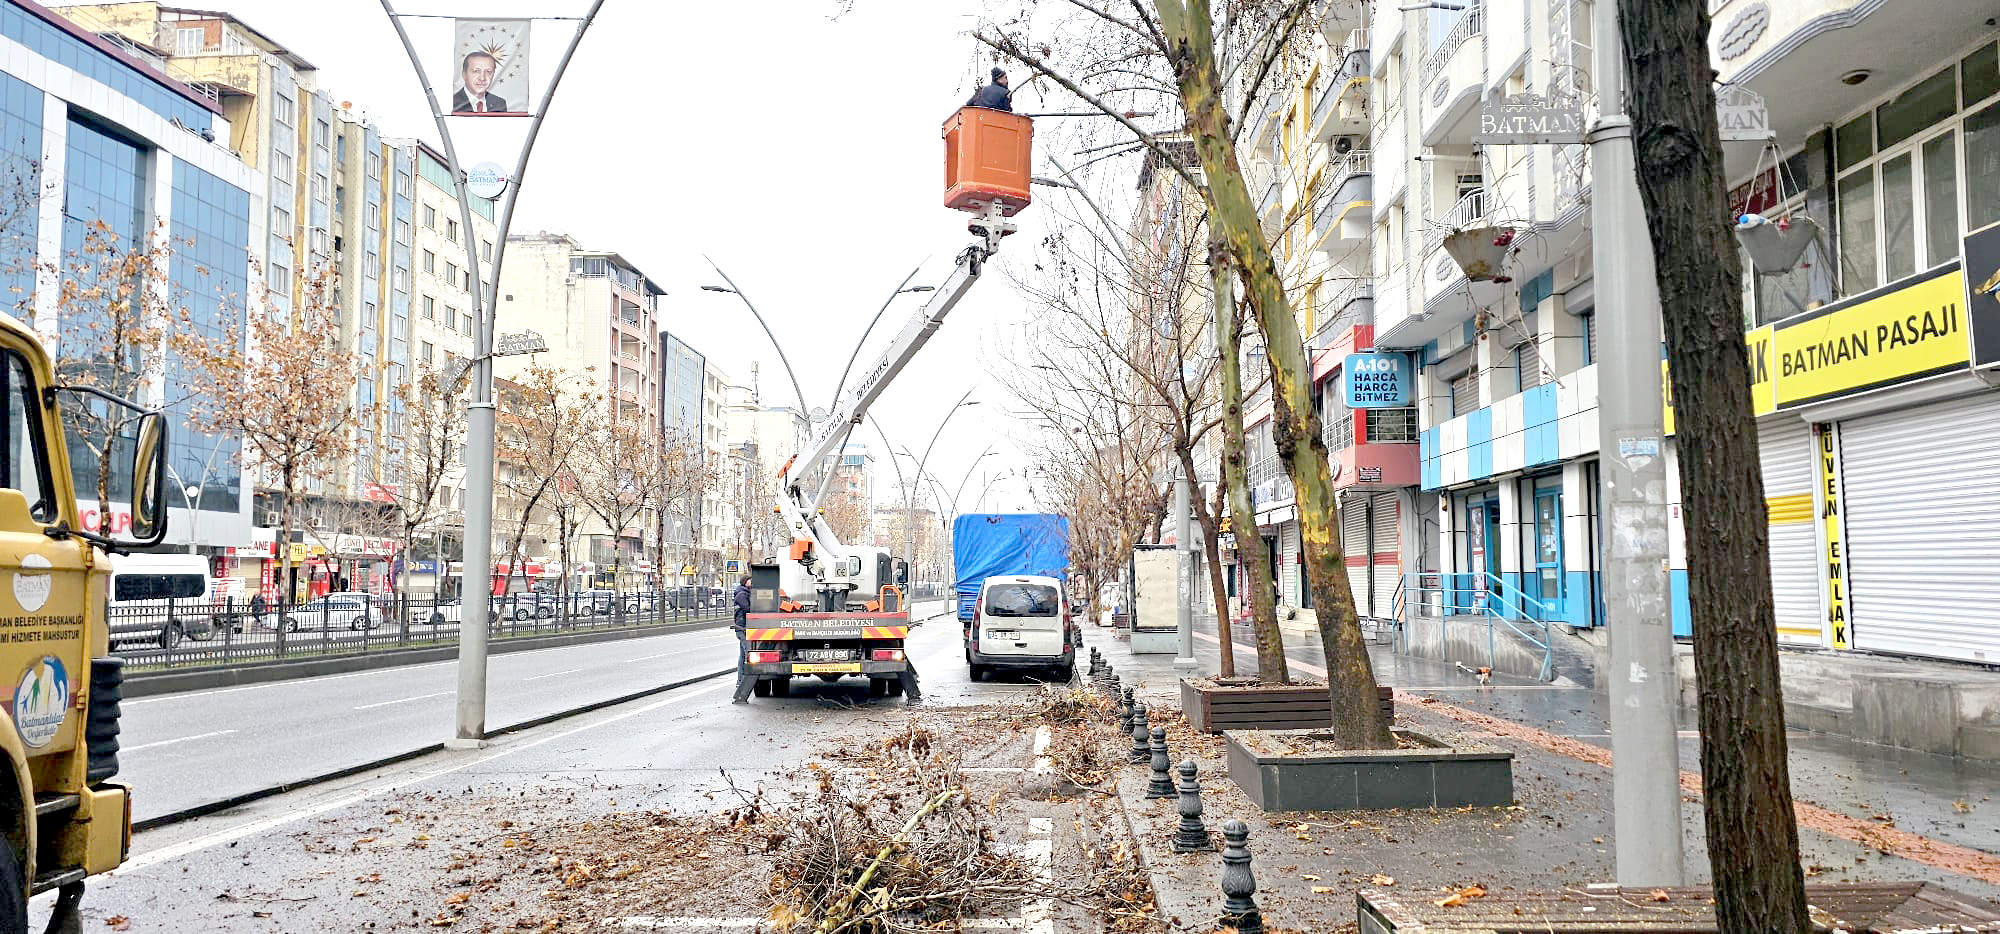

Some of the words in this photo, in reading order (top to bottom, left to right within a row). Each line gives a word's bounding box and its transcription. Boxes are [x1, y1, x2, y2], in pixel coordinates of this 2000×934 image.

[1481, 113, 1580, 133] BATMAN
[498, 338, 545, 353] BATMAN
[1782, 330, 1868, 377] BATMAN
[1877, 303, 1957, 353] PASAJI
[1354, 373, 1398, 382] HARCA
[1354, 383, 1398, 392] HARCA
[1830, 541, 1846, 644] EMLAK
[14, 616, 47, 627] BELEDİYE
[780, 619, 821, 628] BATMAN
[822, 617, 875, 627] BELEDİYESİ
[11, 630, 42, 643] HİZMETE
[43, 629, 80, 641] MAHSUSTUR
[809, 651, 819, 659] 72
